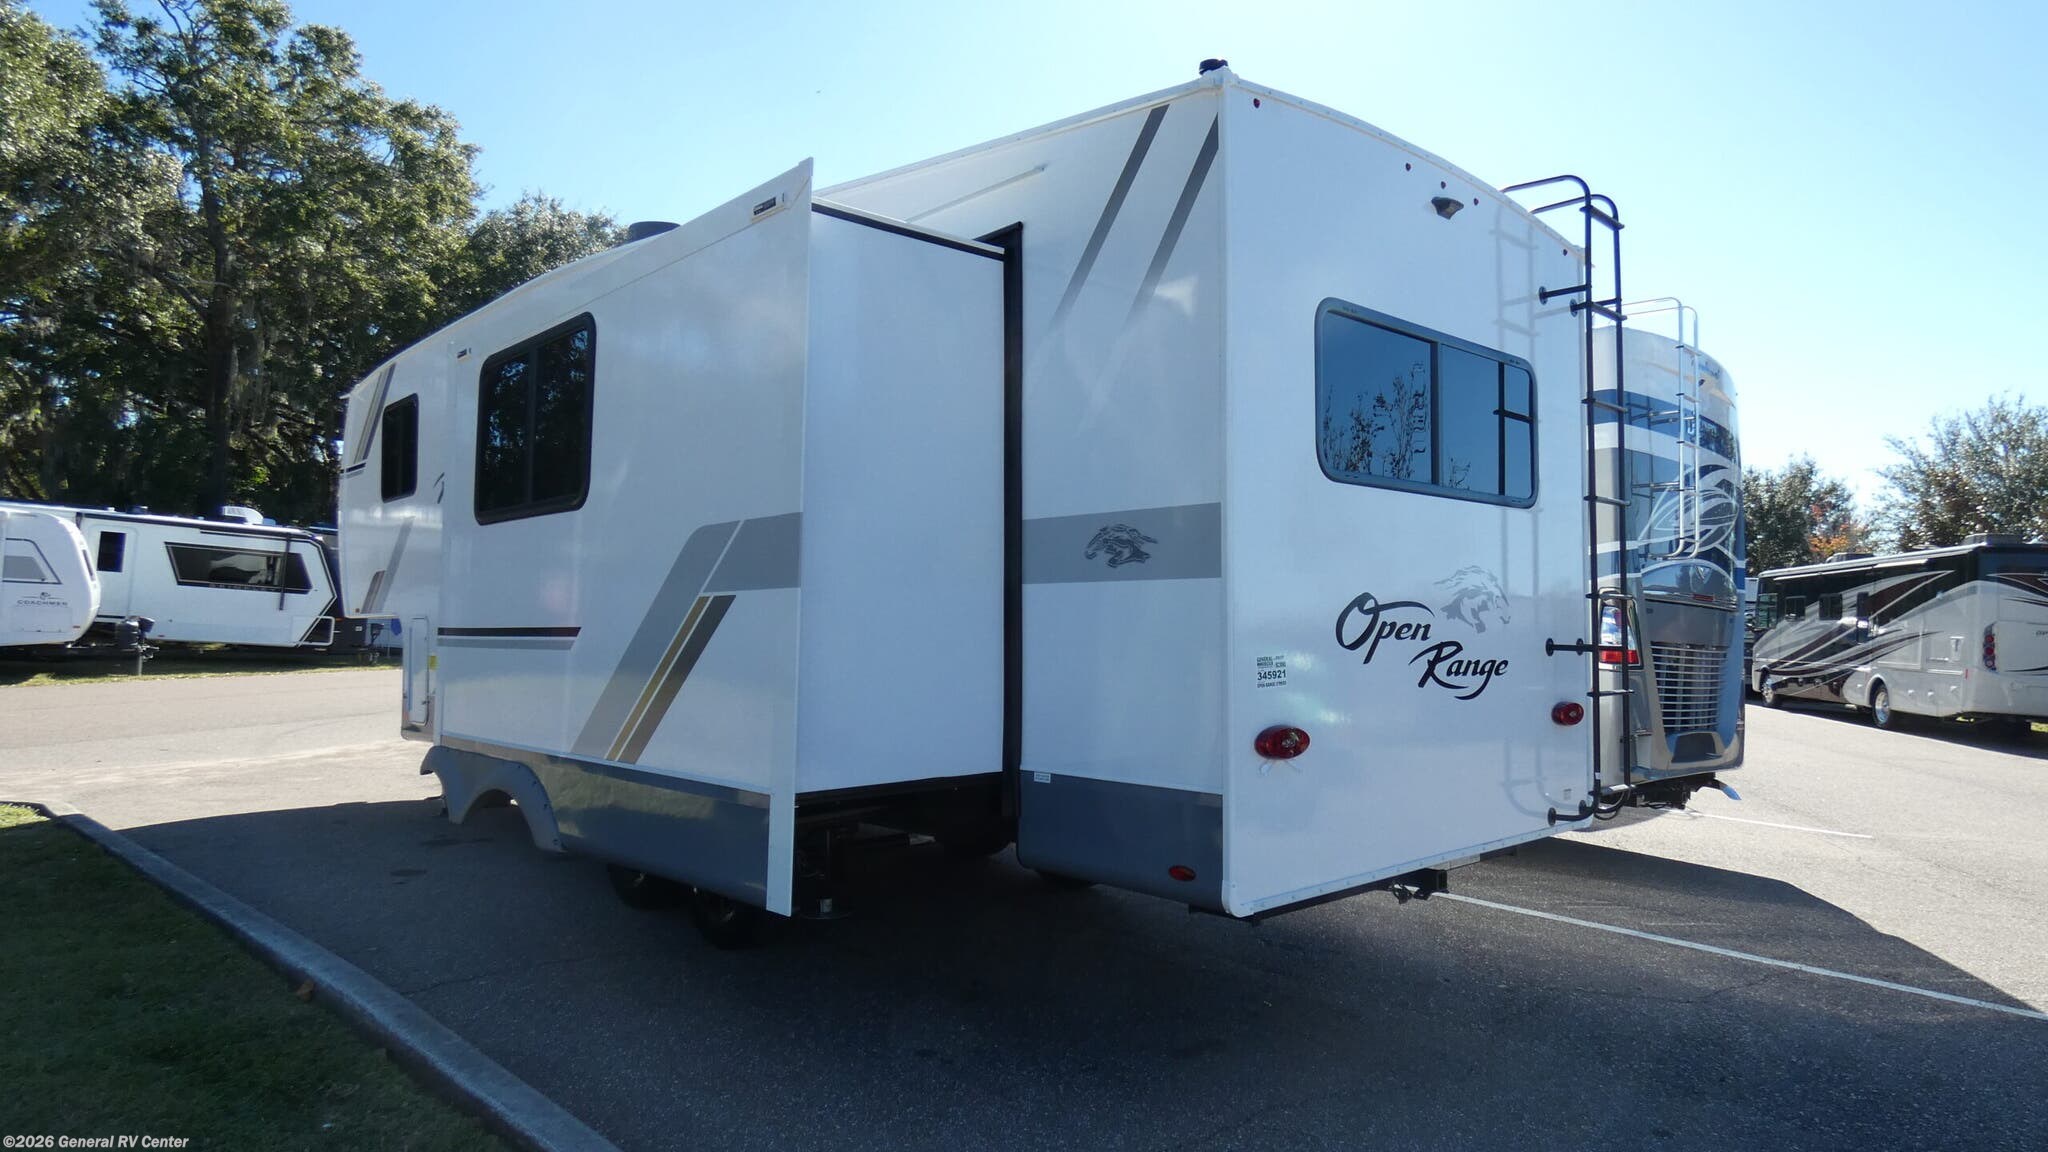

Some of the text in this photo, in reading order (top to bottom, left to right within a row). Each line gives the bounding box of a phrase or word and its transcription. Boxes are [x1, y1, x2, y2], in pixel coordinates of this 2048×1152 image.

[1336, 592, 1435, 664] Open
[1257, 669, 1286, 681] 345921
[1408, 640, 1508, 700] Range
